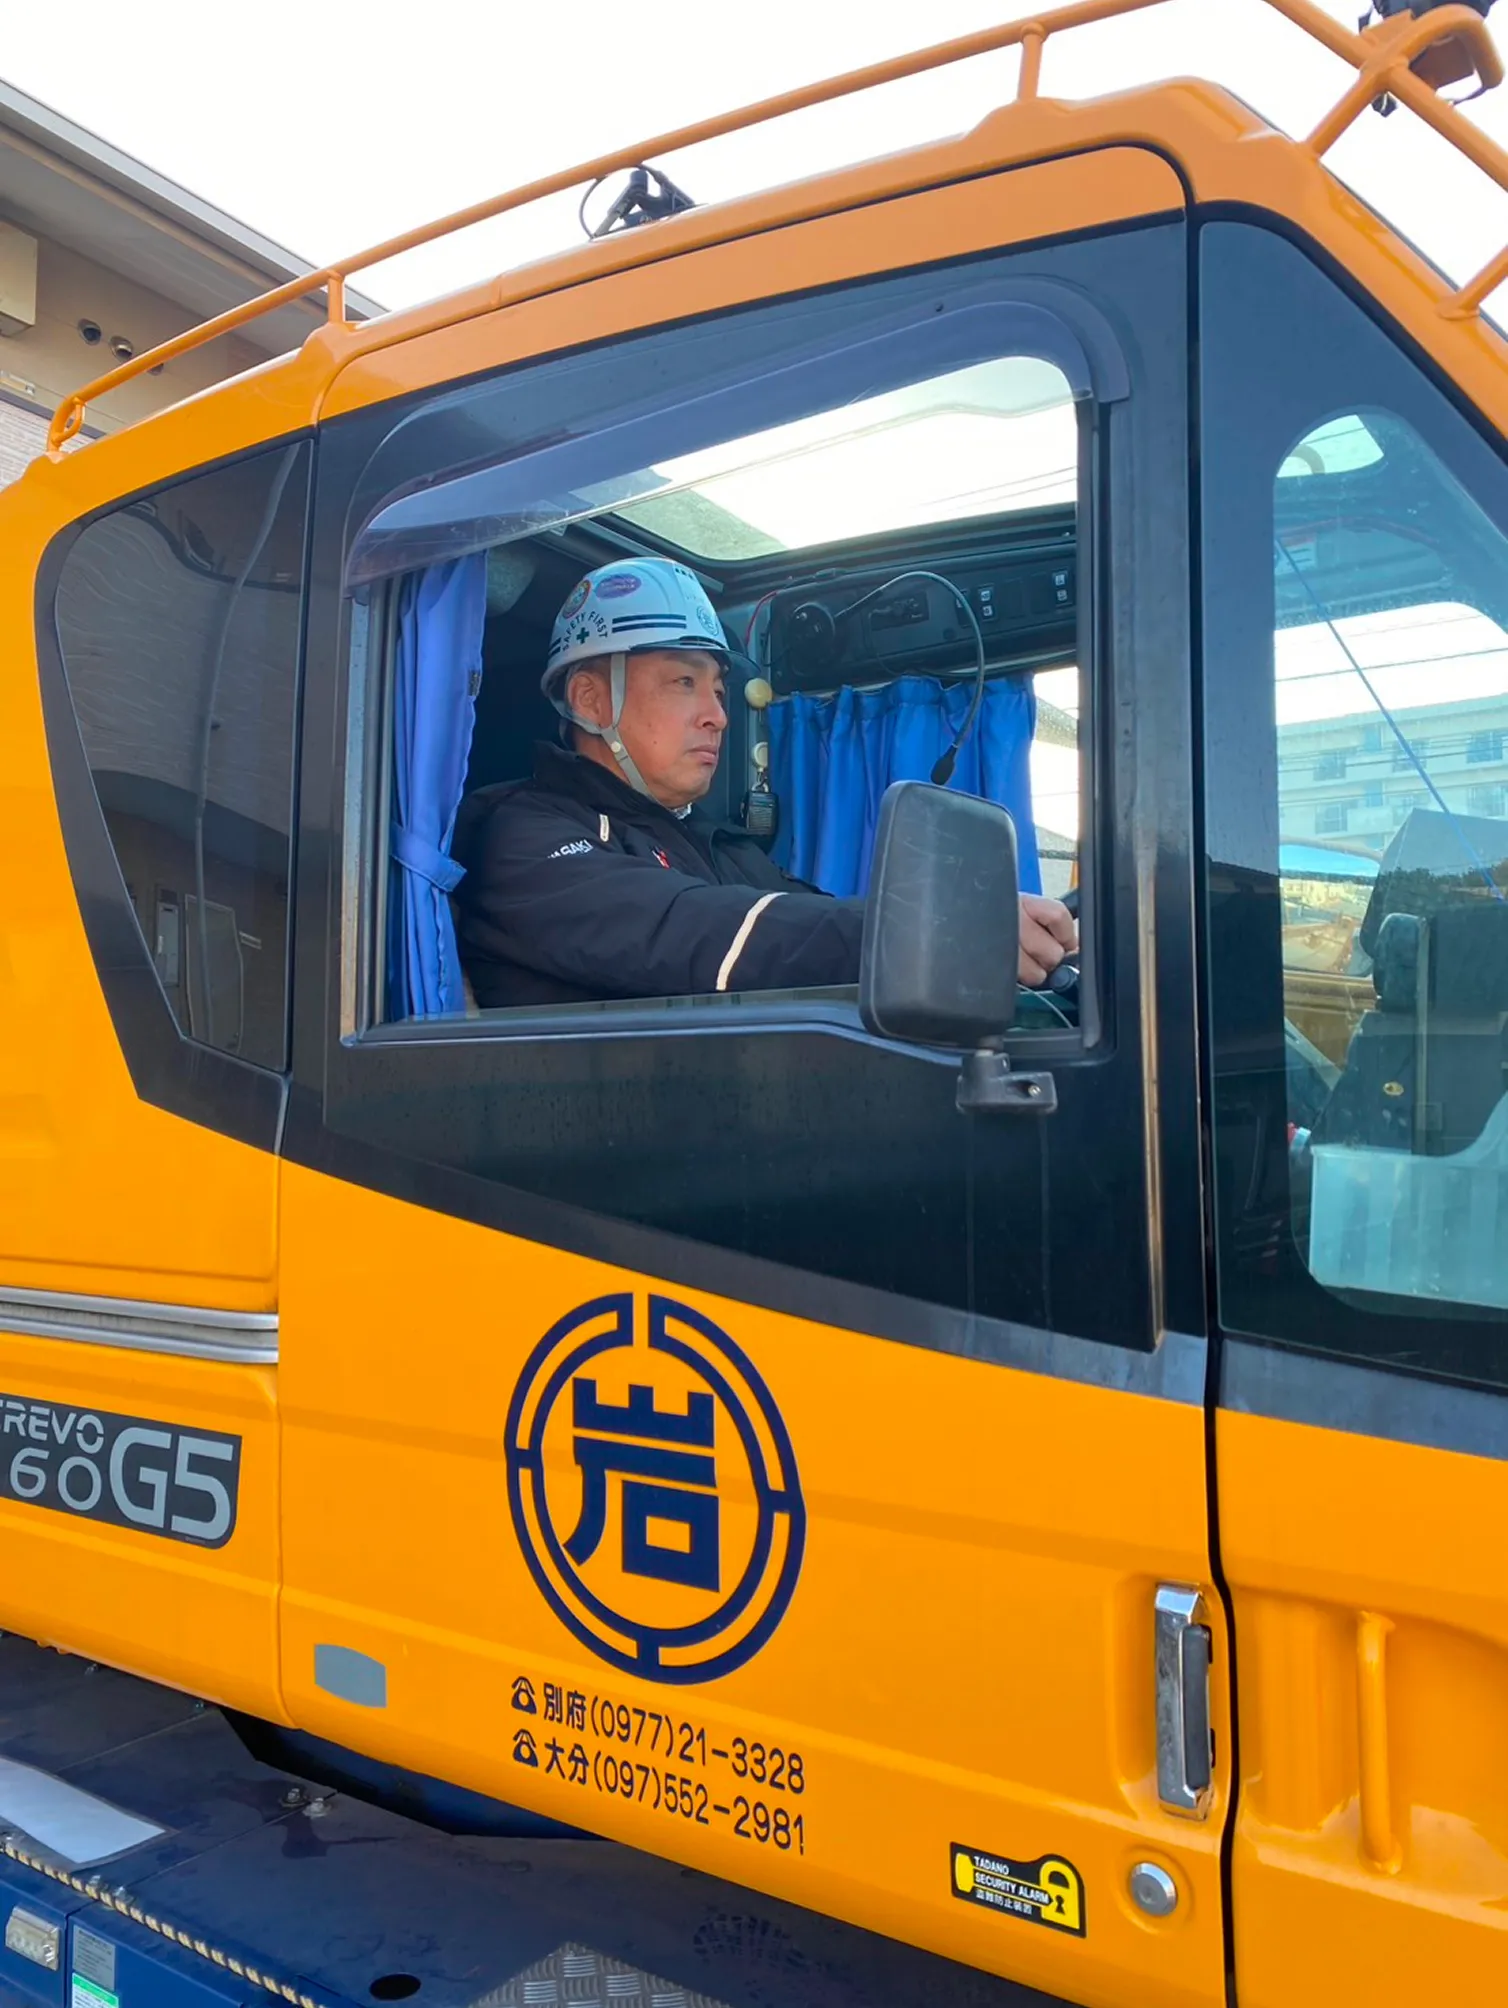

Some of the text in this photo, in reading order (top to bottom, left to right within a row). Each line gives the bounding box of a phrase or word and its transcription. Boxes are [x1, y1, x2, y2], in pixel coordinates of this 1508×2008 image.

[562, 611, 608, 651] SAFETY FIRST
[0, 1399, 104, 1454] REVO
[109, 1427, 234, 1540] G5
[973, 1855, 1010, 1875] TADANO
[975, 1872, 1050, 1904] SECURITY ALARM
